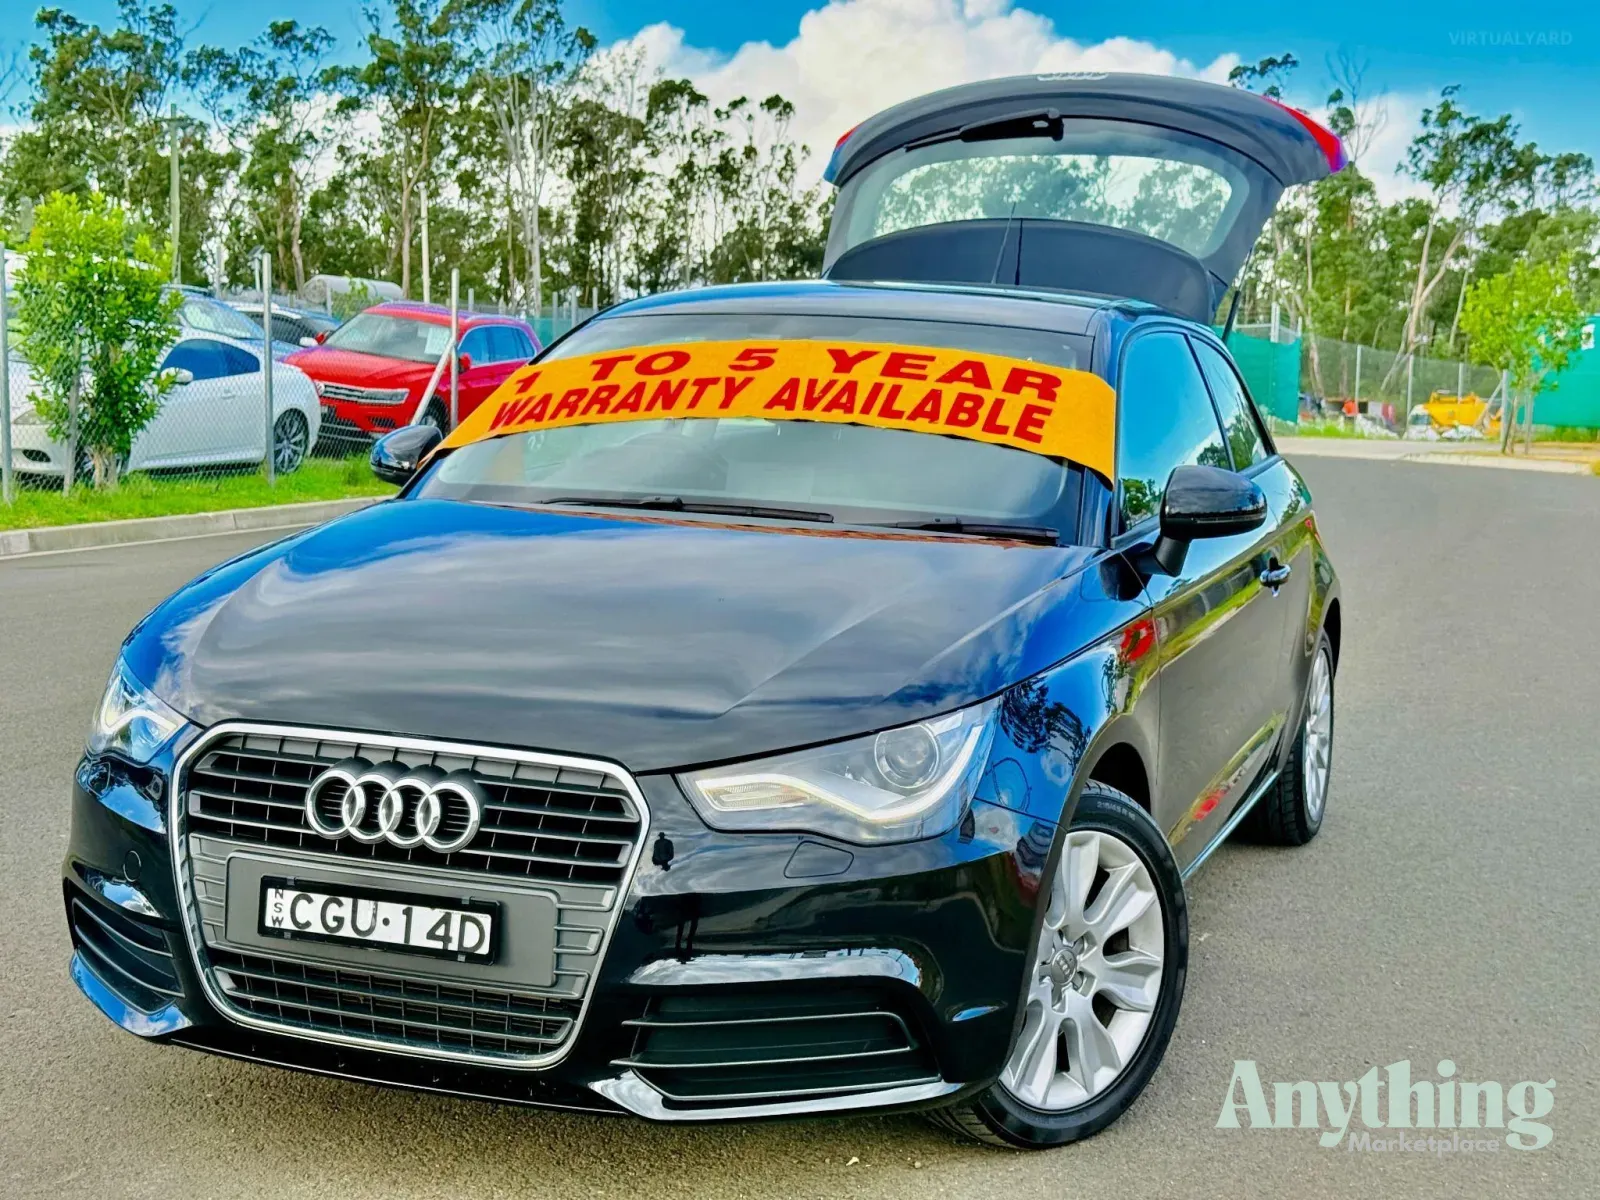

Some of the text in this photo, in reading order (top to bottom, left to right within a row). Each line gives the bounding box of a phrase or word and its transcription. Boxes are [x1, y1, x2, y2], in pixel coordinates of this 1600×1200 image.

[515, 348, 1062, 402] 1 TO 5 YEAR
[488, 377, 1052, 444] WARRANTY AVAILABLE
